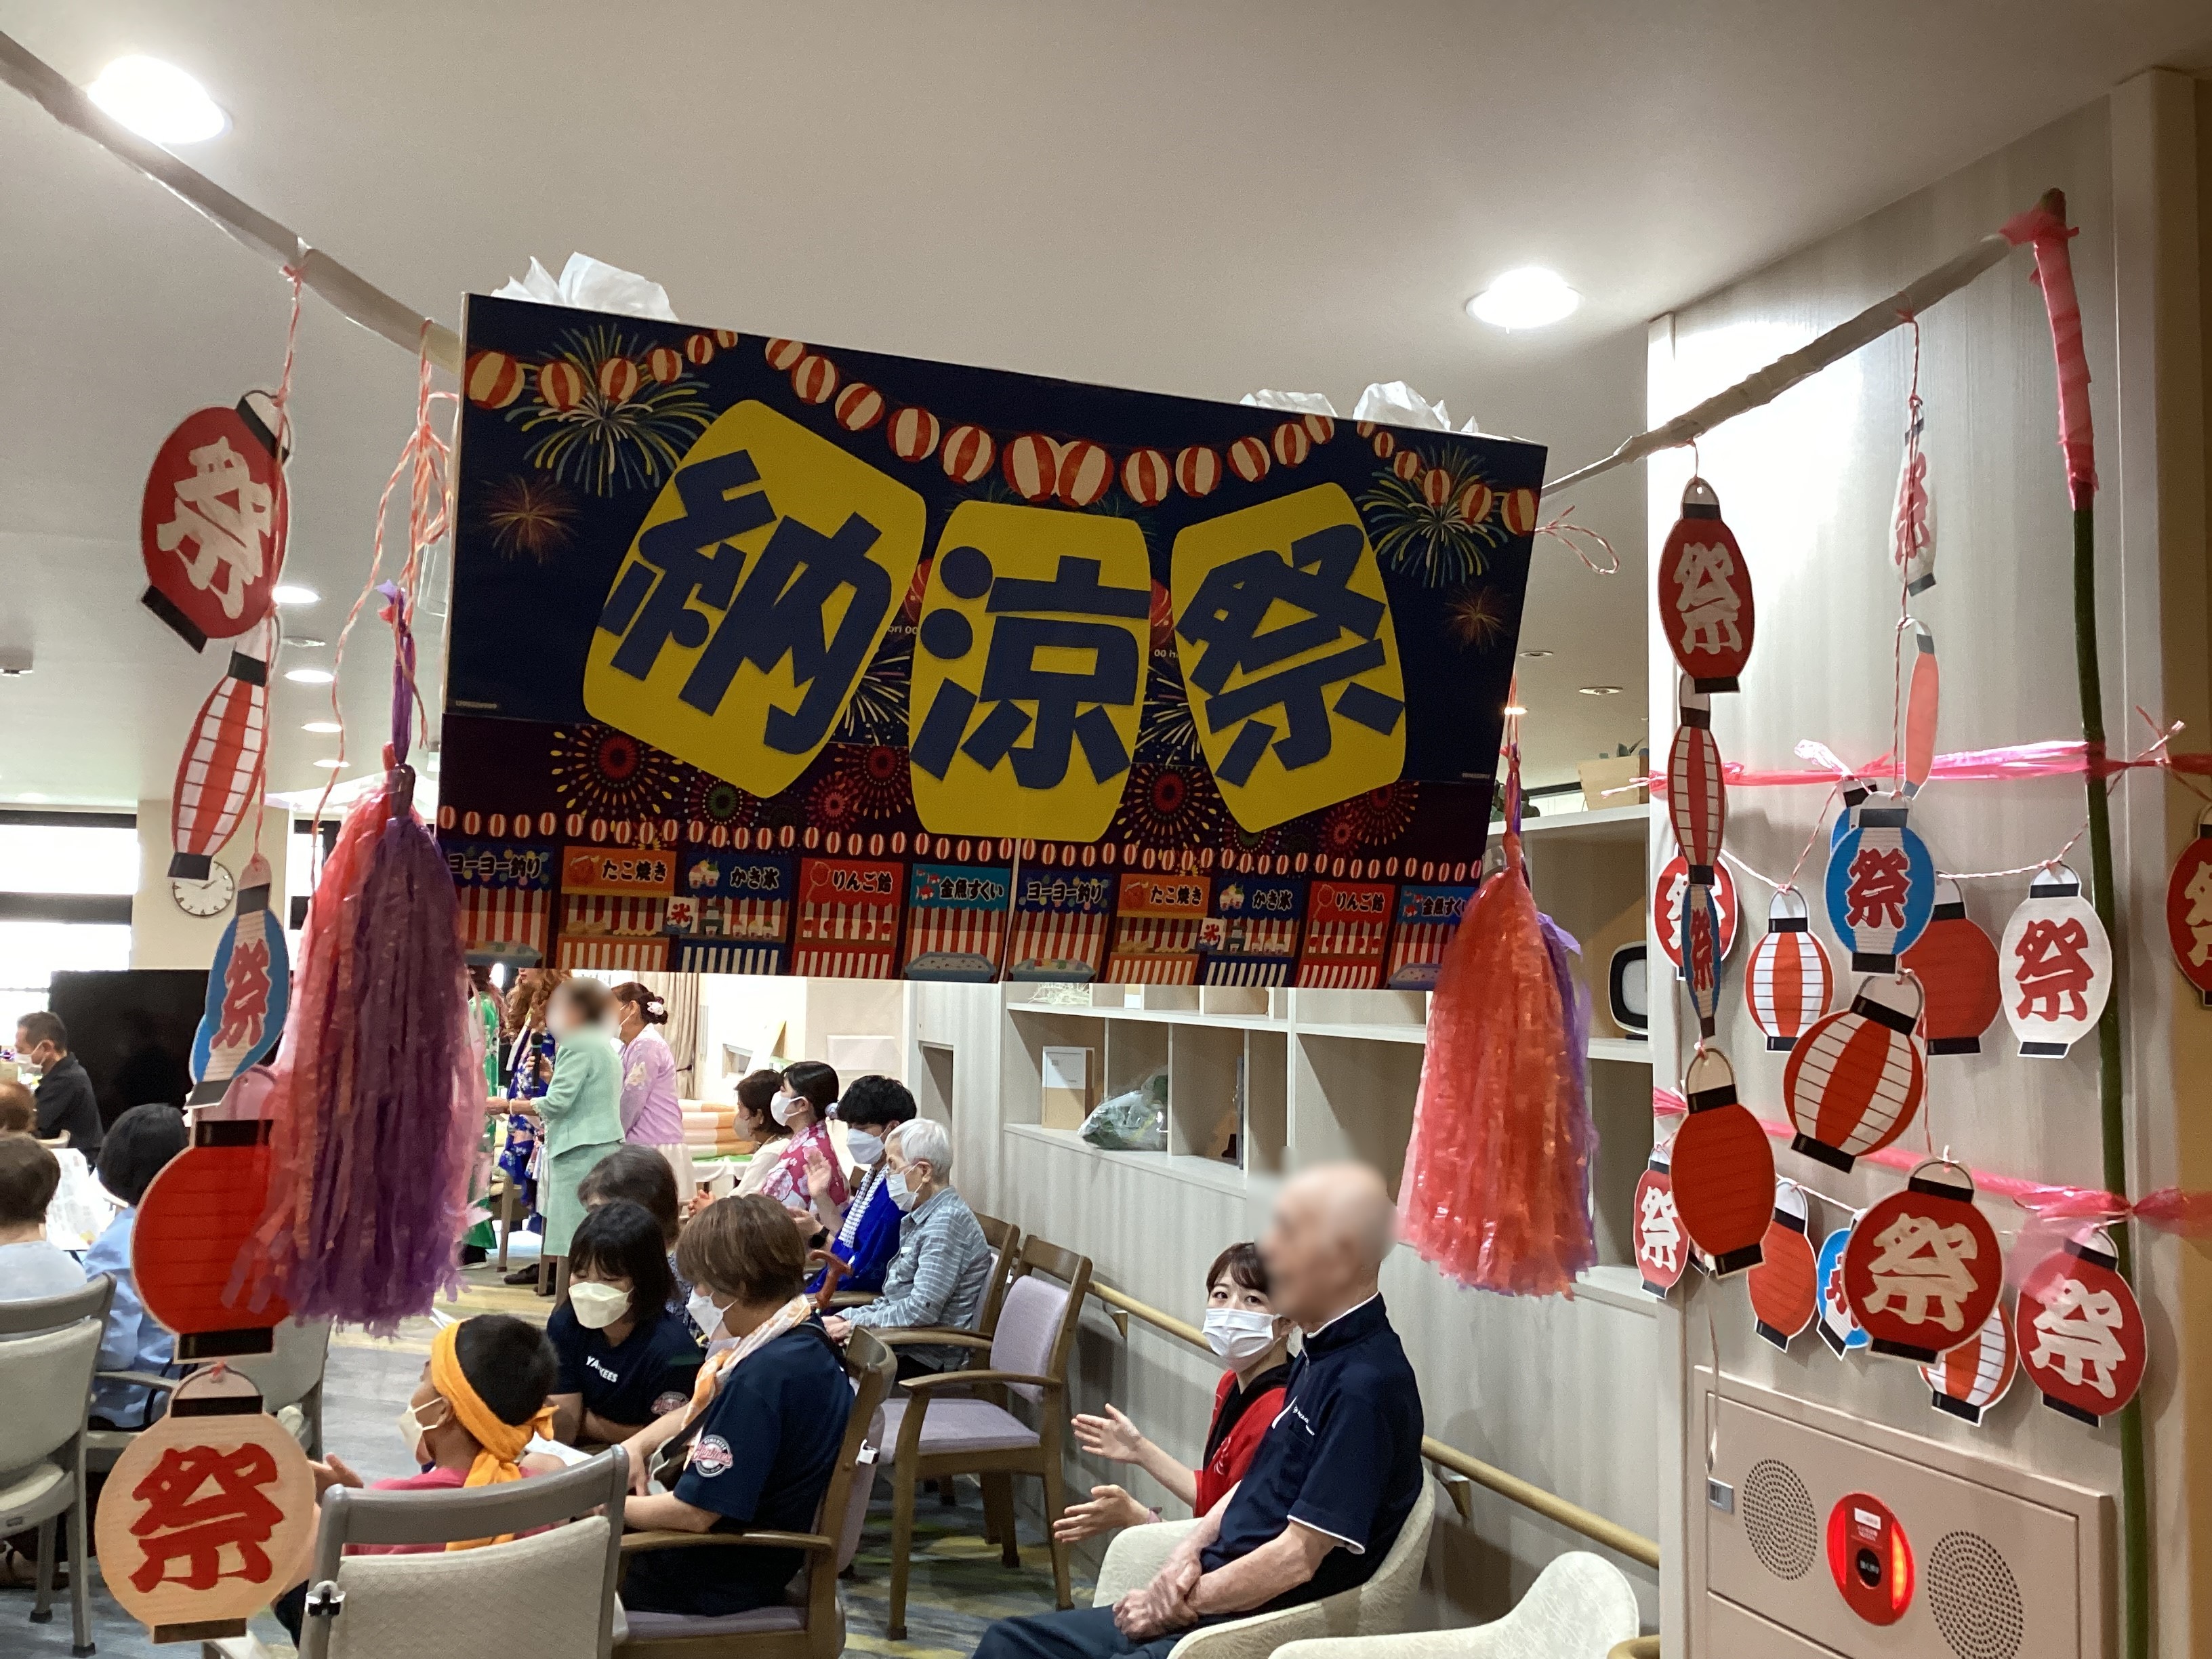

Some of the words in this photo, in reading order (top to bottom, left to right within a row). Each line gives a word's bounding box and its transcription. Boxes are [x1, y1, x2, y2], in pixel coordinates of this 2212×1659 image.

[157, 436, 272, 619] 祭
[602, 449, 1405, 789] 納涼祭
[1673, 541, 1742, 654] 祭
[448, 853, 541, 879] ヨーヨー釣り
[602, 859, 668, 883] たこ焼き
[730, 866, 779, 890] かき氷
[833, 870, 893, 894] りんご飴
[939, 876, 1004, 901] 金魚すくい
[1027, 881, 1103, 903] ヨーヨー釣り
[1846, 847, 1912, 930] 祭
[671, 903, 691, 924] 氷
[1150, 884, 1202, 906] たこ焼き
[1252, 889, 1293, 911] かき氷
[1335, 892, 1385, 914] りんご飴
[1203, 924, 1220, 942] 氷
[1689, 907, 1715, 991] 祭
[211, 938, 272, 1049] 祭
[2015, 917, 2095, 1022] 祭
[1640, 1185, 1681, 1272] 祭
[1861, 1212, 1980, 1332] 祭
[2030, 1272, 2127, 1399] 祭
[128, 1443, 285, 1593] 祭
